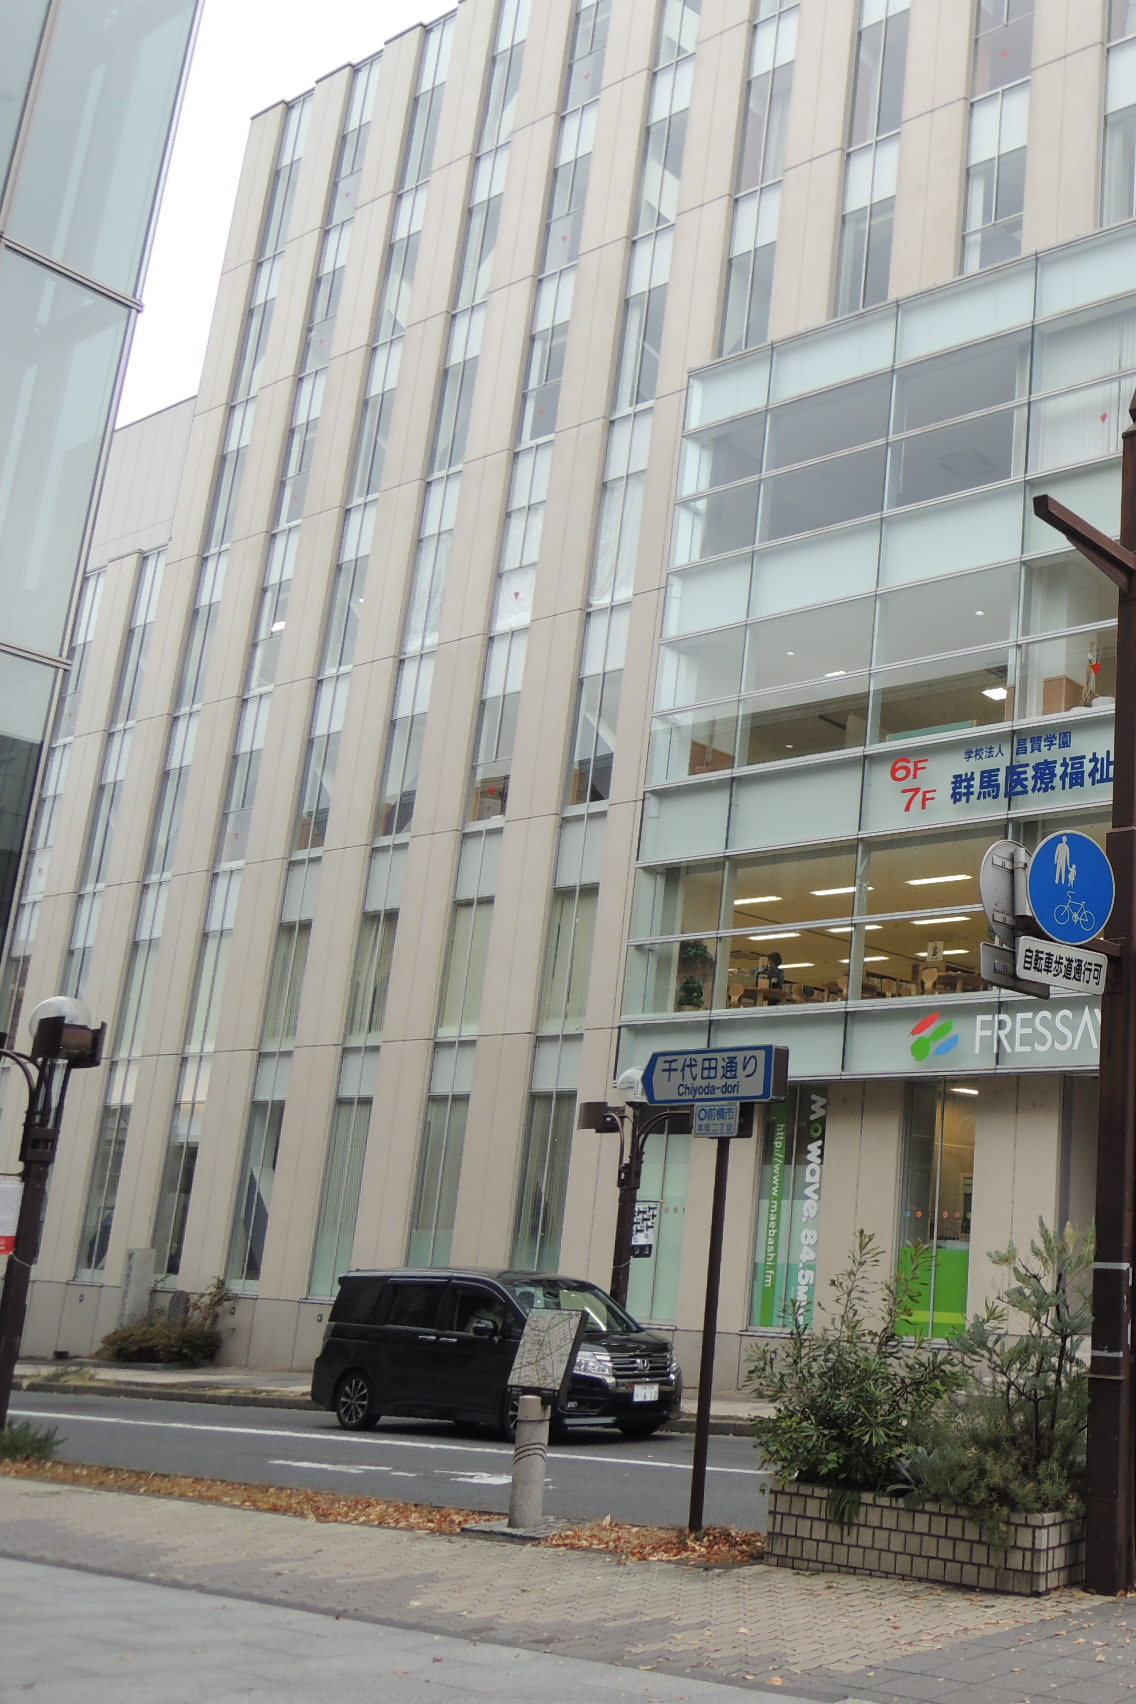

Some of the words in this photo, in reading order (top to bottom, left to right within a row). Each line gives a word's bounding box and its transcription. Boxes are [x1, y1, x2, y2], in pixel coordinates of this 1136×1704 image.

[963, 743, 1005, 763] 学校法人
[1015, 730, 1073, 756] 昌賢学園
[890, 757, 929, 783] 6F
[900, 787, 937, 813] 7F
[1022, 946, 1103, 986] 自転車歩道通行可
[974, 1004, 1102, 1054] FRESSA
[661, 1054, 758, 1082] 千代田通り
[677, 1081, 740, 1098] Chiyoda-dori
